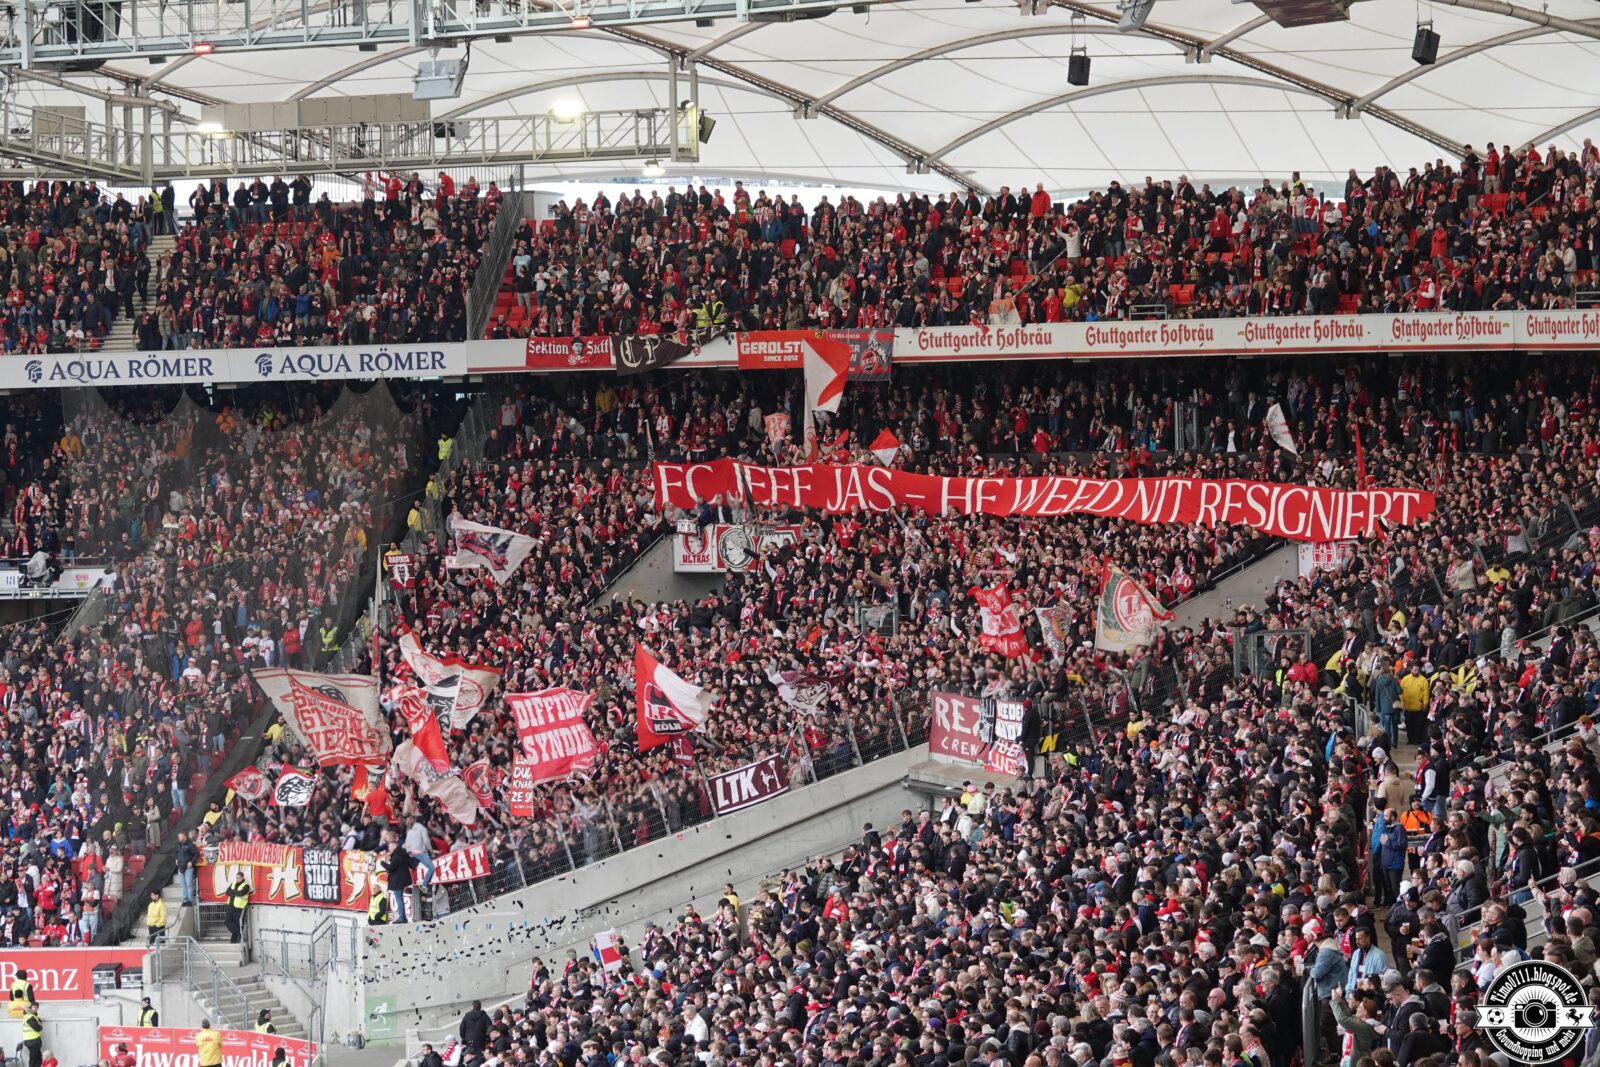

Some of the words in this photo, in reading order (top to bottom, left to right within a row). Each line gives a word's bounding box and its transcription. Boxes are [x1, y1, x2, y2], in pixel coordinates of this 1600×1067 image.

[918, 330, 993, 356] Stuttgarter
[996, 328, 1053, 354] Hofbräu
[1085, 326, 1158, 352] Stuttgarter
[1160, 325, 1214, 349] Hofbräu
[1245, 321, 1310, 347] Stuttgarter
[1313, 319, 1364, 344] Hofbräu
[279, 353, 351, 374] AQUA
[359, 347, 447, 371] RÖMER
[529, 340, 569, 354] Sektion
[49, 359, 124, 381] AQUA
[128, 354, 214, 377] RÖMER
[657, 464, 717, 506] FC
[827, 467, 896, 512] JAS
[1009, 477, 1124, 515] WEED
[1119, 479, 1192, 522] NIT
[1196, 482, 1420, 539] RESIGNIERT
[682, 554, 710, 564] ULTRAS
[654, 721, 682, 732] KÖLN
[941, 736, 980, 757] CREW
[715, 767, 759, 808] LTK
